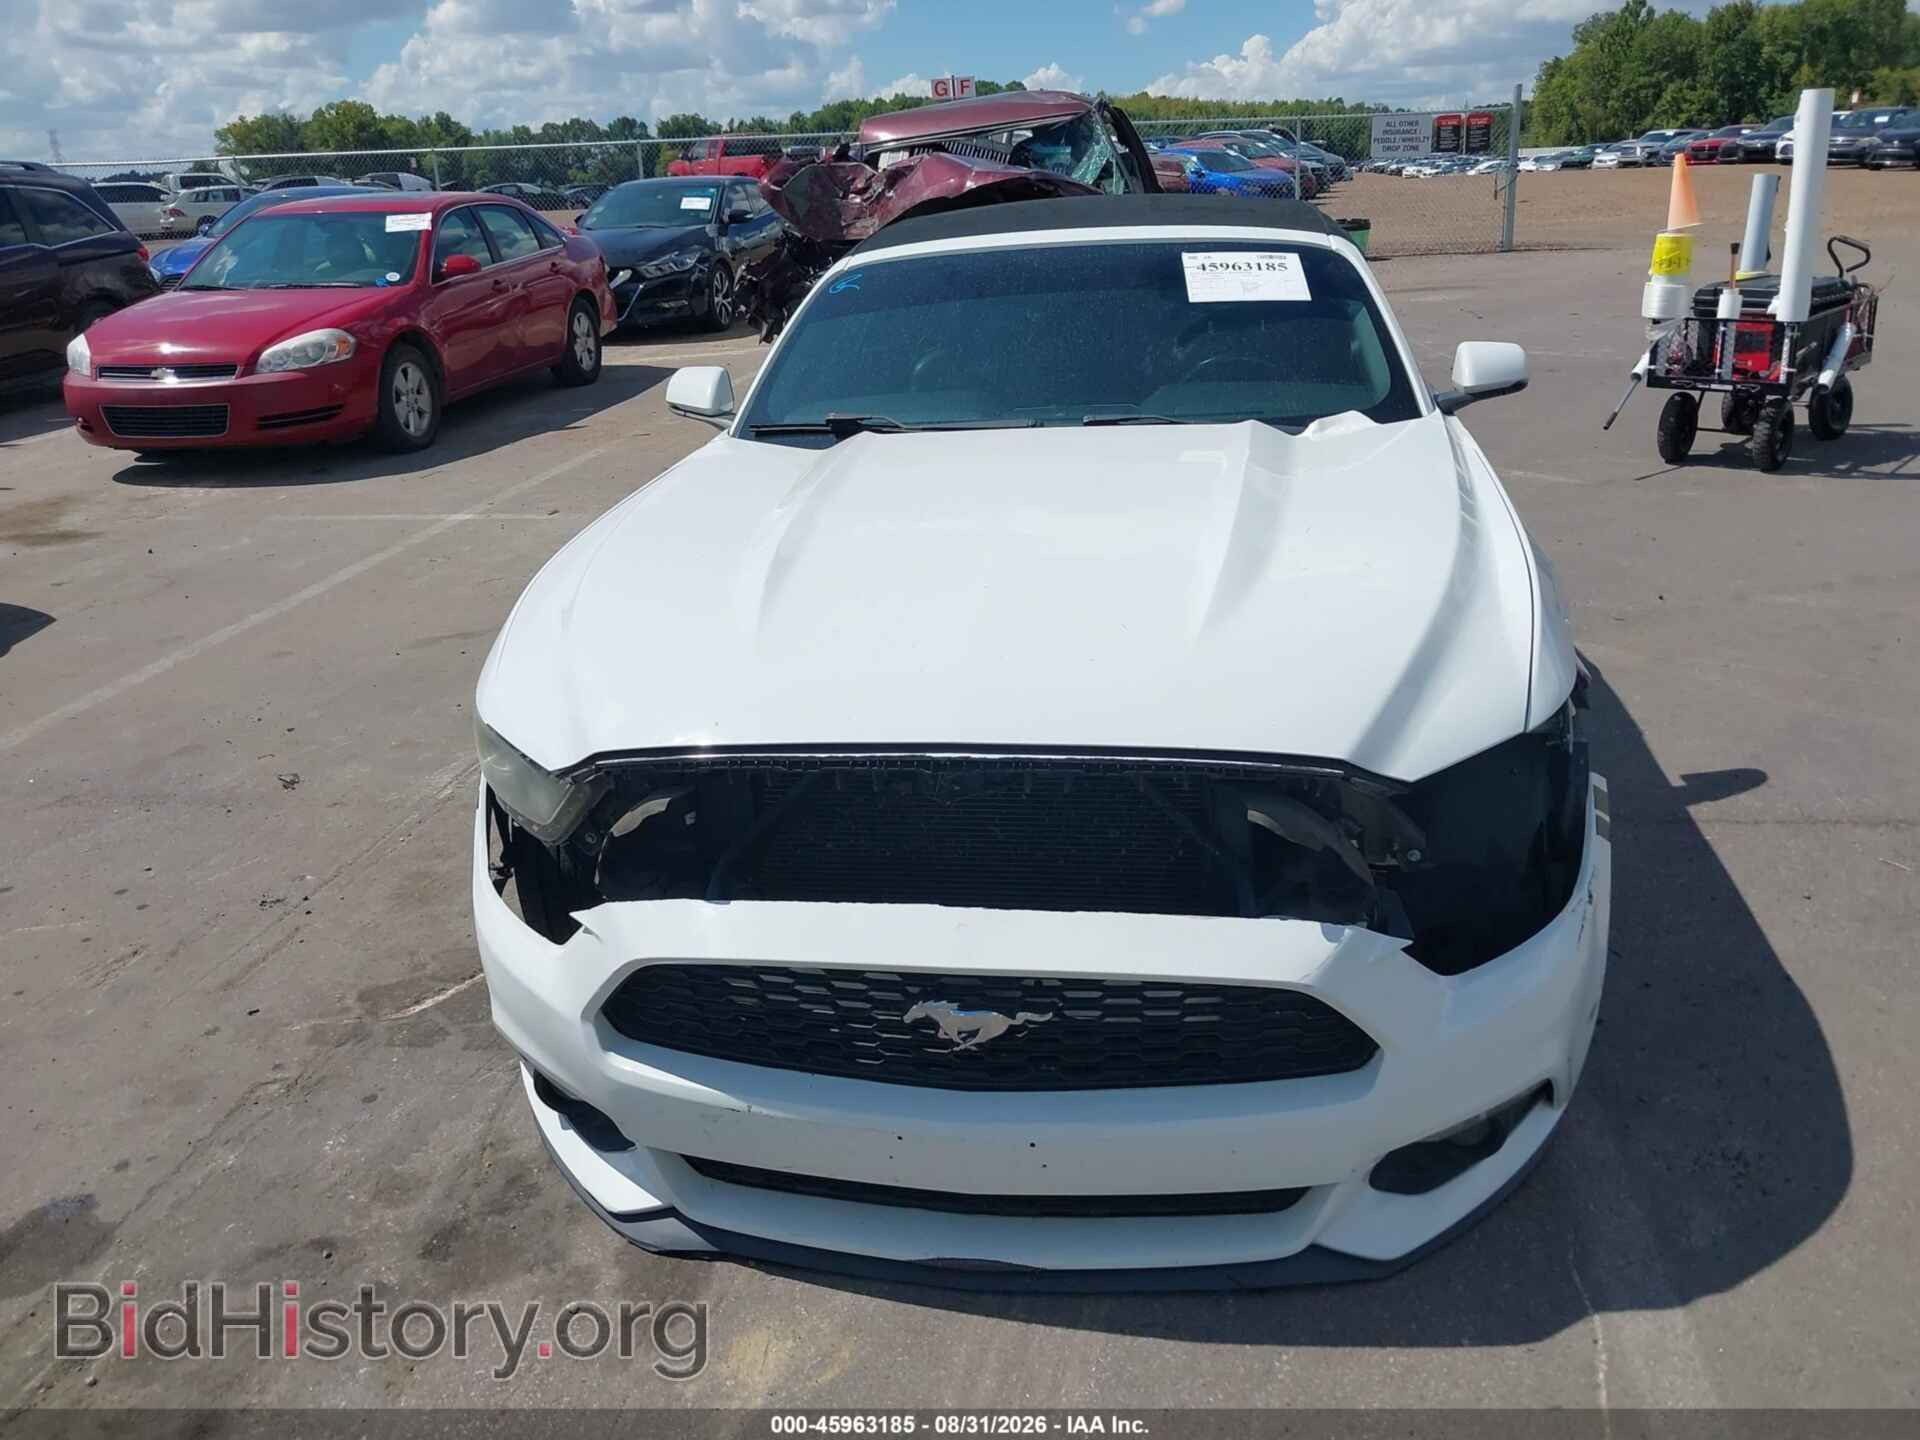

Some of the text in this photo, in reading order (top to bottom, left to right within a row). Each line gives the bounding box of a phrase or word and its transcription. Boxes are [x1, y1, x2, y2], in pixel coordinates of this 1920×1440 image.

[934, 81, 948, 97] G
[960, 79, 970, 95] F
[1382, 144, 1420, 152] DROP ZONE
[1197, 262, 1288, 272] 45963185
